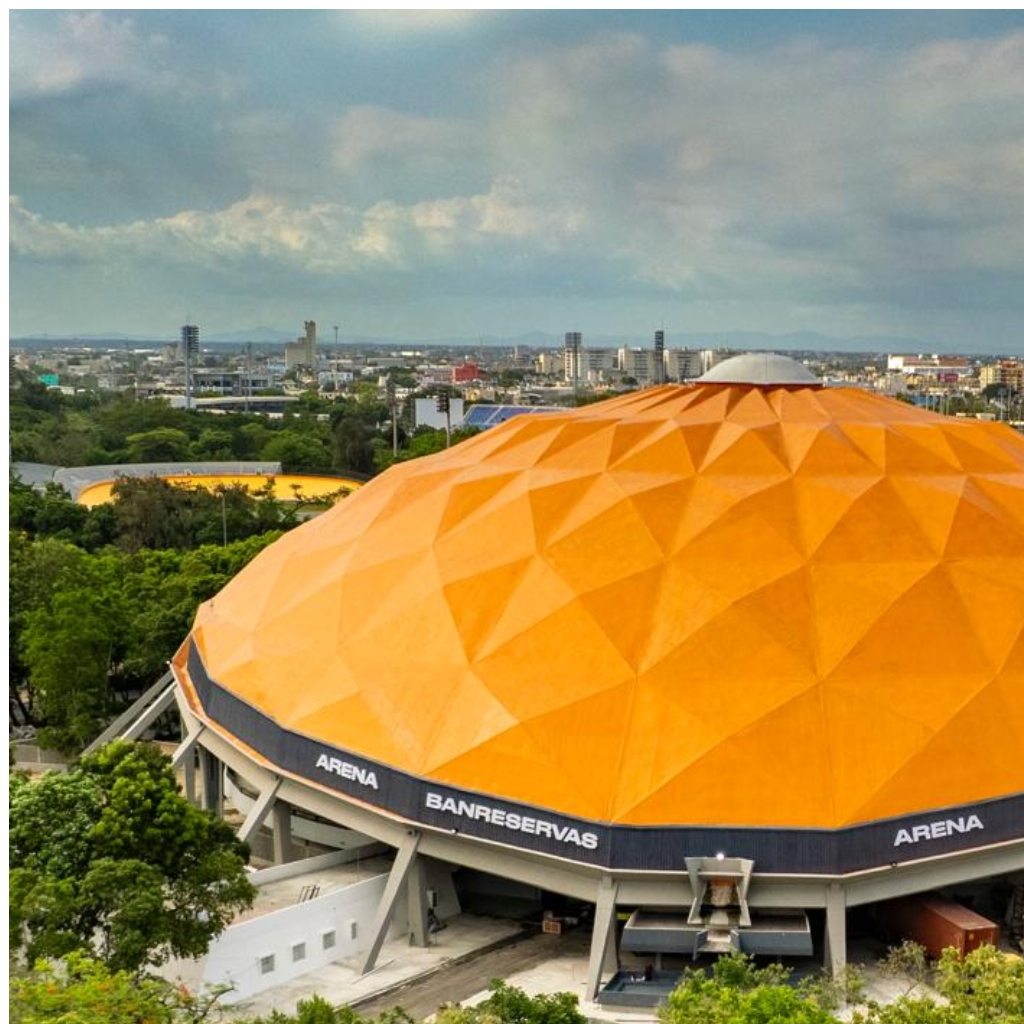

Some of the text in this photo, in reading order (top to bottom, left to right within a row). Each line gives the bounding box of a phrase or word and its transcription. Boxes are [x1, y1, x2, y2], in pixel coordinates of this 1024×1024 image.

[316, 754, 378, 789] ARENA
[425, 792, 599, 850] BANRESERVAS
[893, 814, 984, 846] ARENA
